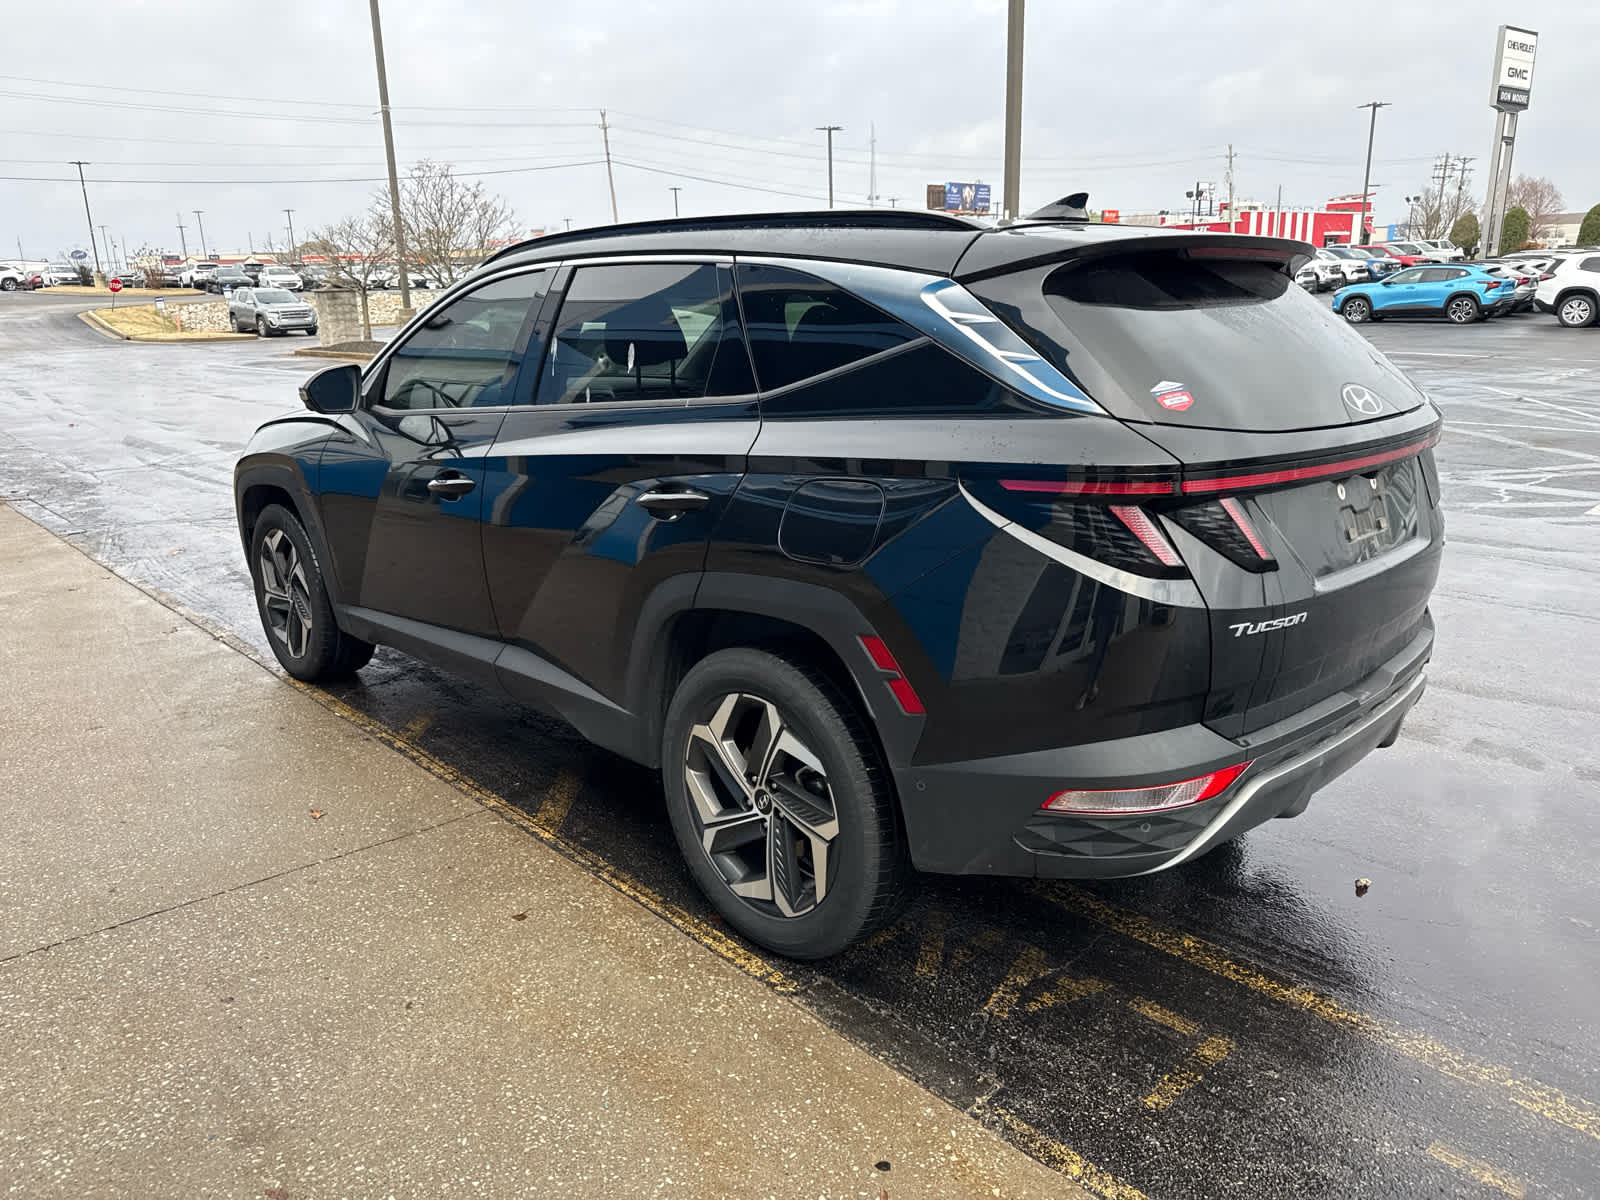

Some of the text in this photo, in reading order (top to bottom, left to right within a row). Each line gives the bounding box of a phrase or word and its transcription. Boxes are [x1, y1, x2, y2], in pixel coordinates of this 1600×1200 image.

[1508, 40, 1535, 53] CHEVROLET
[1508, 67, 1528, 80] GMC
[1501, 91, 1528, 104] DON MOORE
